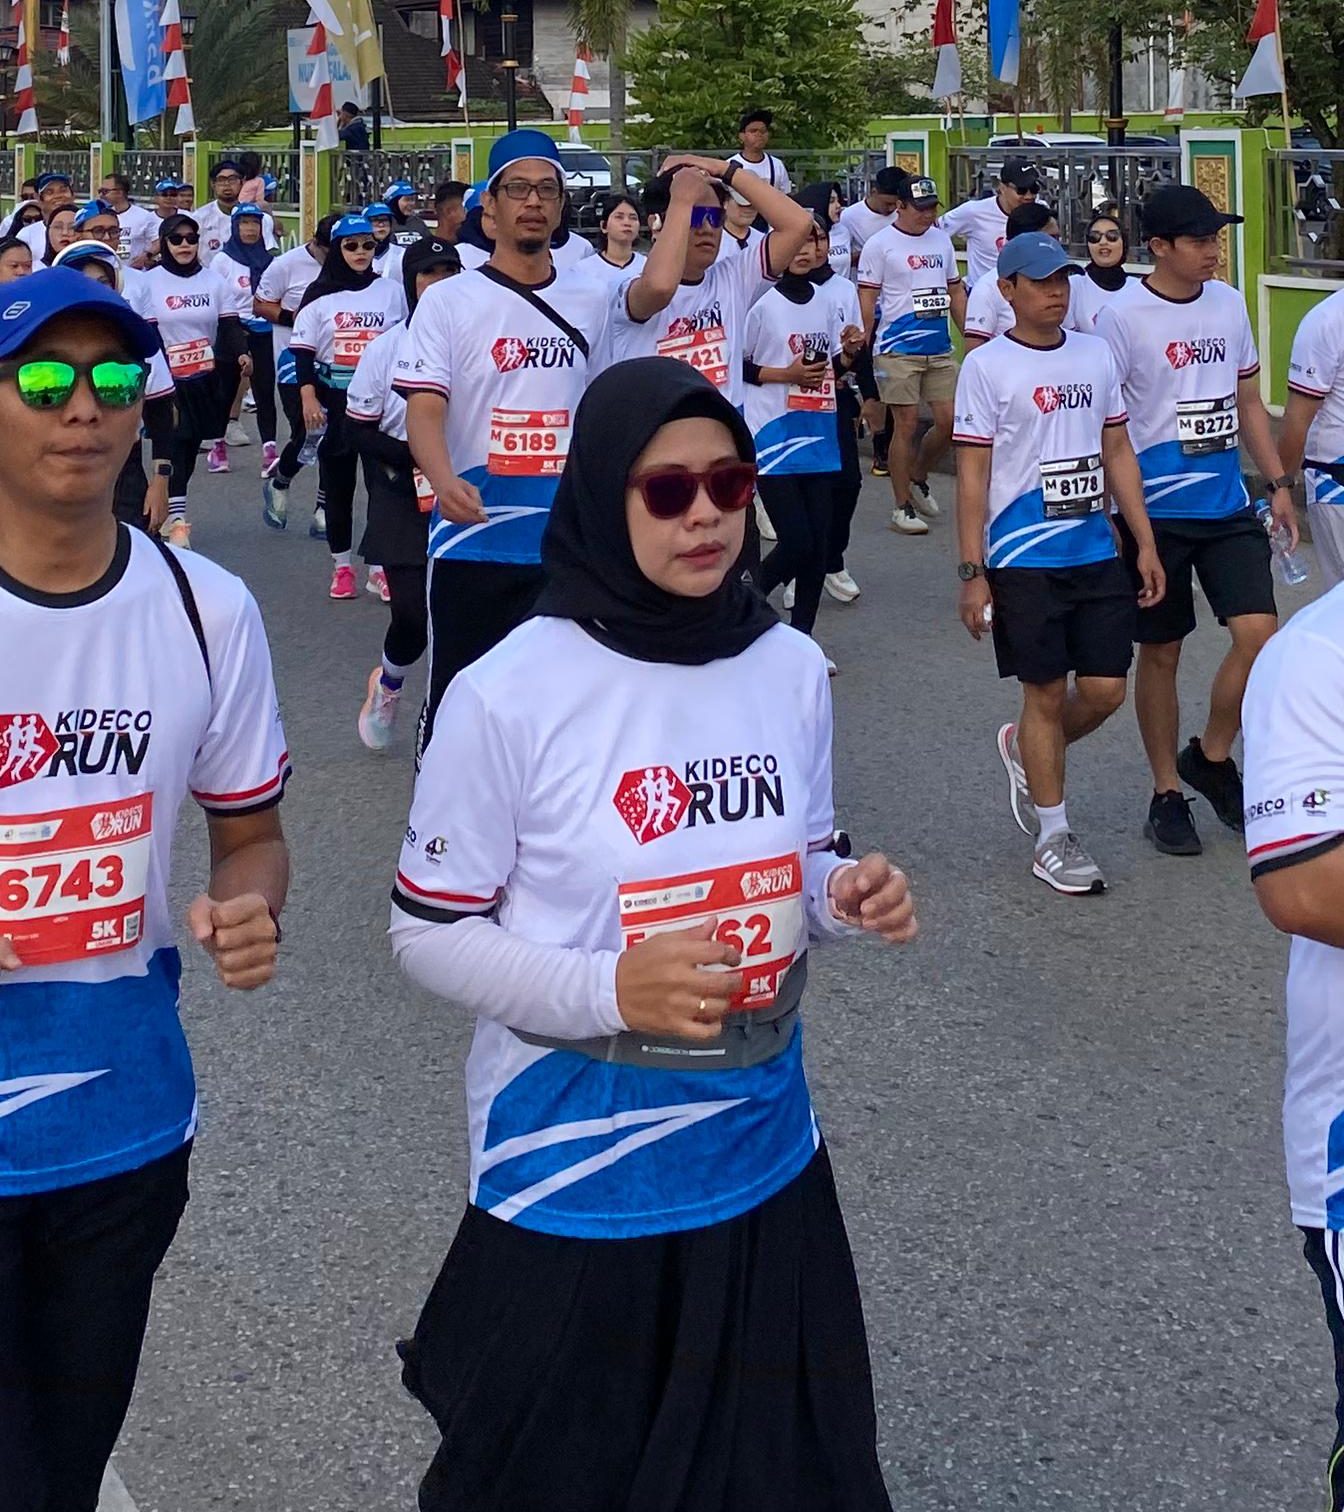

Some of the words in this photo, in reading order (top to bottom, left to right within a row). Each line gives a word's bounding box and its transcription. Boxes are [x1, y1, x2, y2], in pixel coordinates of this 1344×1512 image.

[921, 256, 944, 269] RUN
[184, 296, 210, 309] RUN
[353, 316, 385, 328] RUN
[525, 337, 575, 348] KIDECO
[1190, 338, 1226, 348] KIDECO
[178, 349, 206, 364] 5727
[522, 348, 575, 369] RUN
[1189, 347, 1226, 365] RUN
[1057, 384, 1093, 393] KIDECO
[1057, 392, 1093, 409] RUN
[1178, 418, 1192, 429] M
[1193, 414, 1234, 436] 8272
[490, 429, 502, 442] M
[503, 432, 557, 452] 6189
[1044, 479, 1057, 491] M
[1059, 475, 1099, 497] 8178
[55, 708, 153, 734] KIDECO
[43, 732, 152, 779] RUN
[684, 754, 779, 783] KIDECO
[682, 775, 785, 830] RUN
[1244, 798, 1285, 818] DECO
[112, 814, 143, 836] RUN
[760, 873, 794, 896] RUN
[90, 919, 118, 940] 5K
[749, 975, 772, 995] 5K
